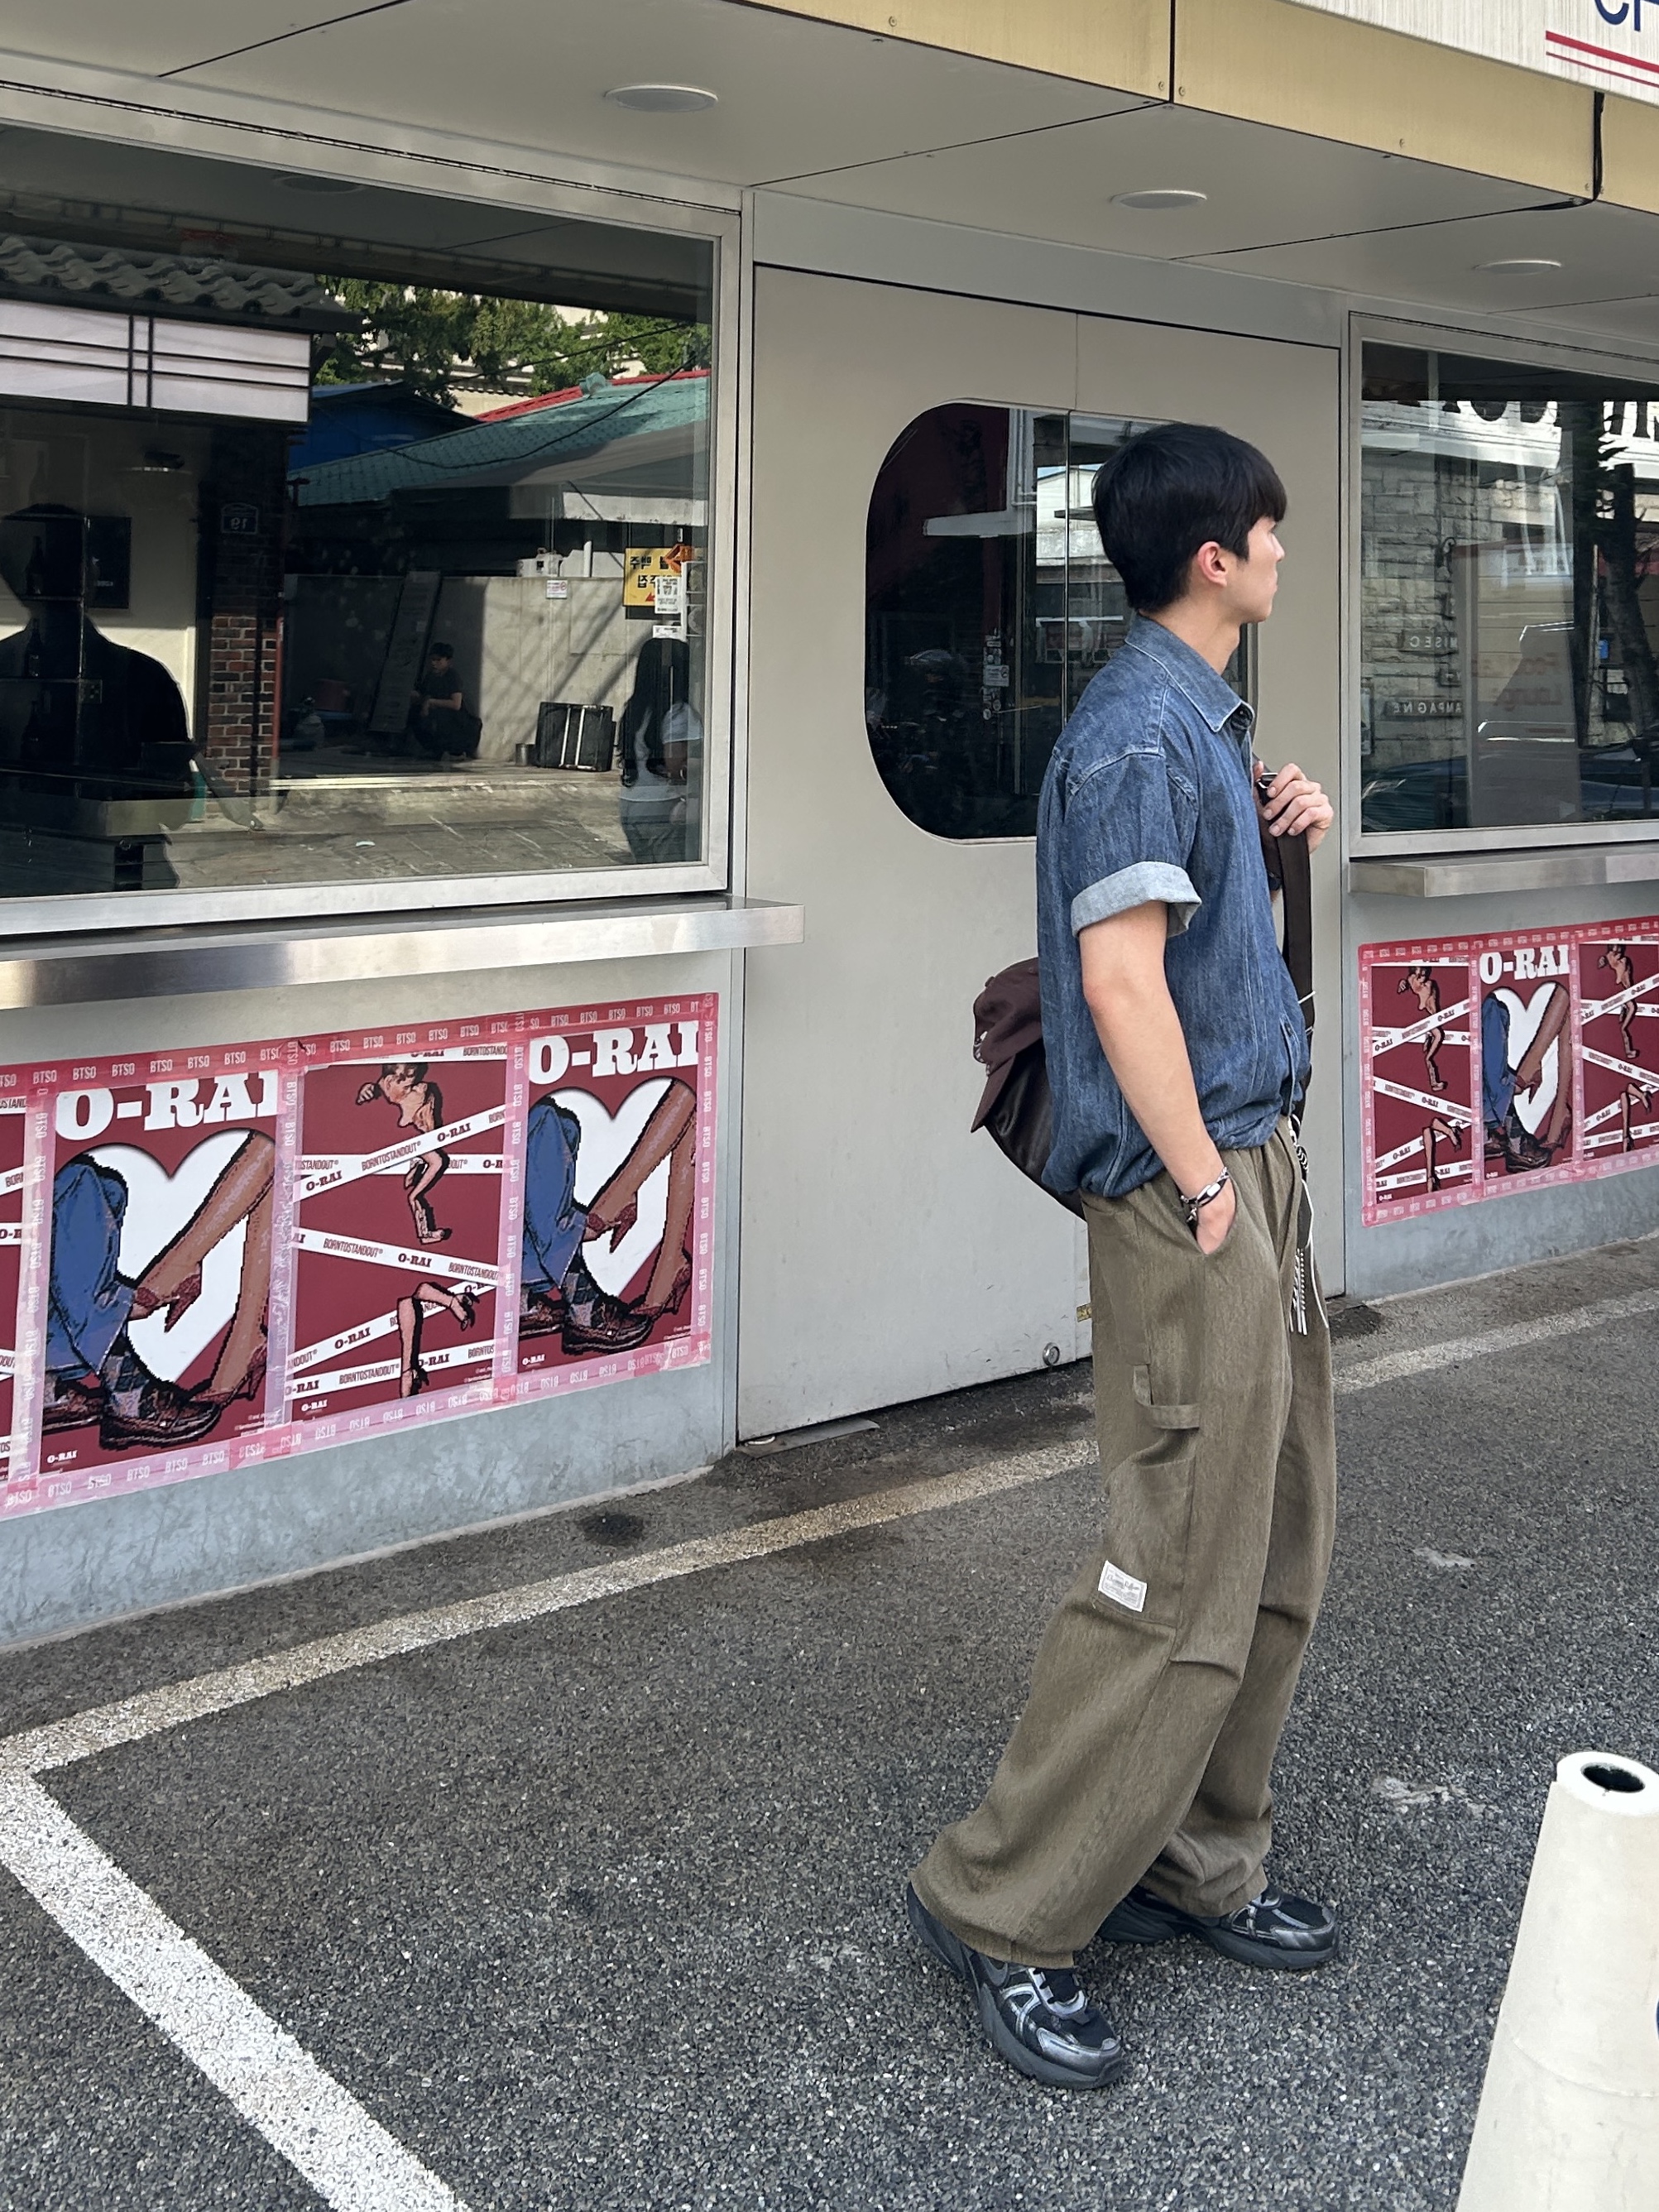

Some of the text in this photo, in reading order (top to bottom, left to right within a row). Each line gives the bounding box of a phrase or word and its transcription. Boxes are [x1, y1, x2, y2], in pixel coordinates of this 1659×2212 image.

[1479, 944, 1570, 984] O-RAI
[529, 1020, 699, 1085] O-RAI
[55, 1068, 279, 1140] O-RAI
[306, 1170, 343, 1191] O-RAI
[437, 1123, 471, 1142] O-RAI
[398, 1253, 432, 1268] O-RAI
[334, 1327, 371, 1349] O-RAI
[301, 1399, 328, 1412] O-RAI
[47, 1450, 78, 1464] O-RAI
